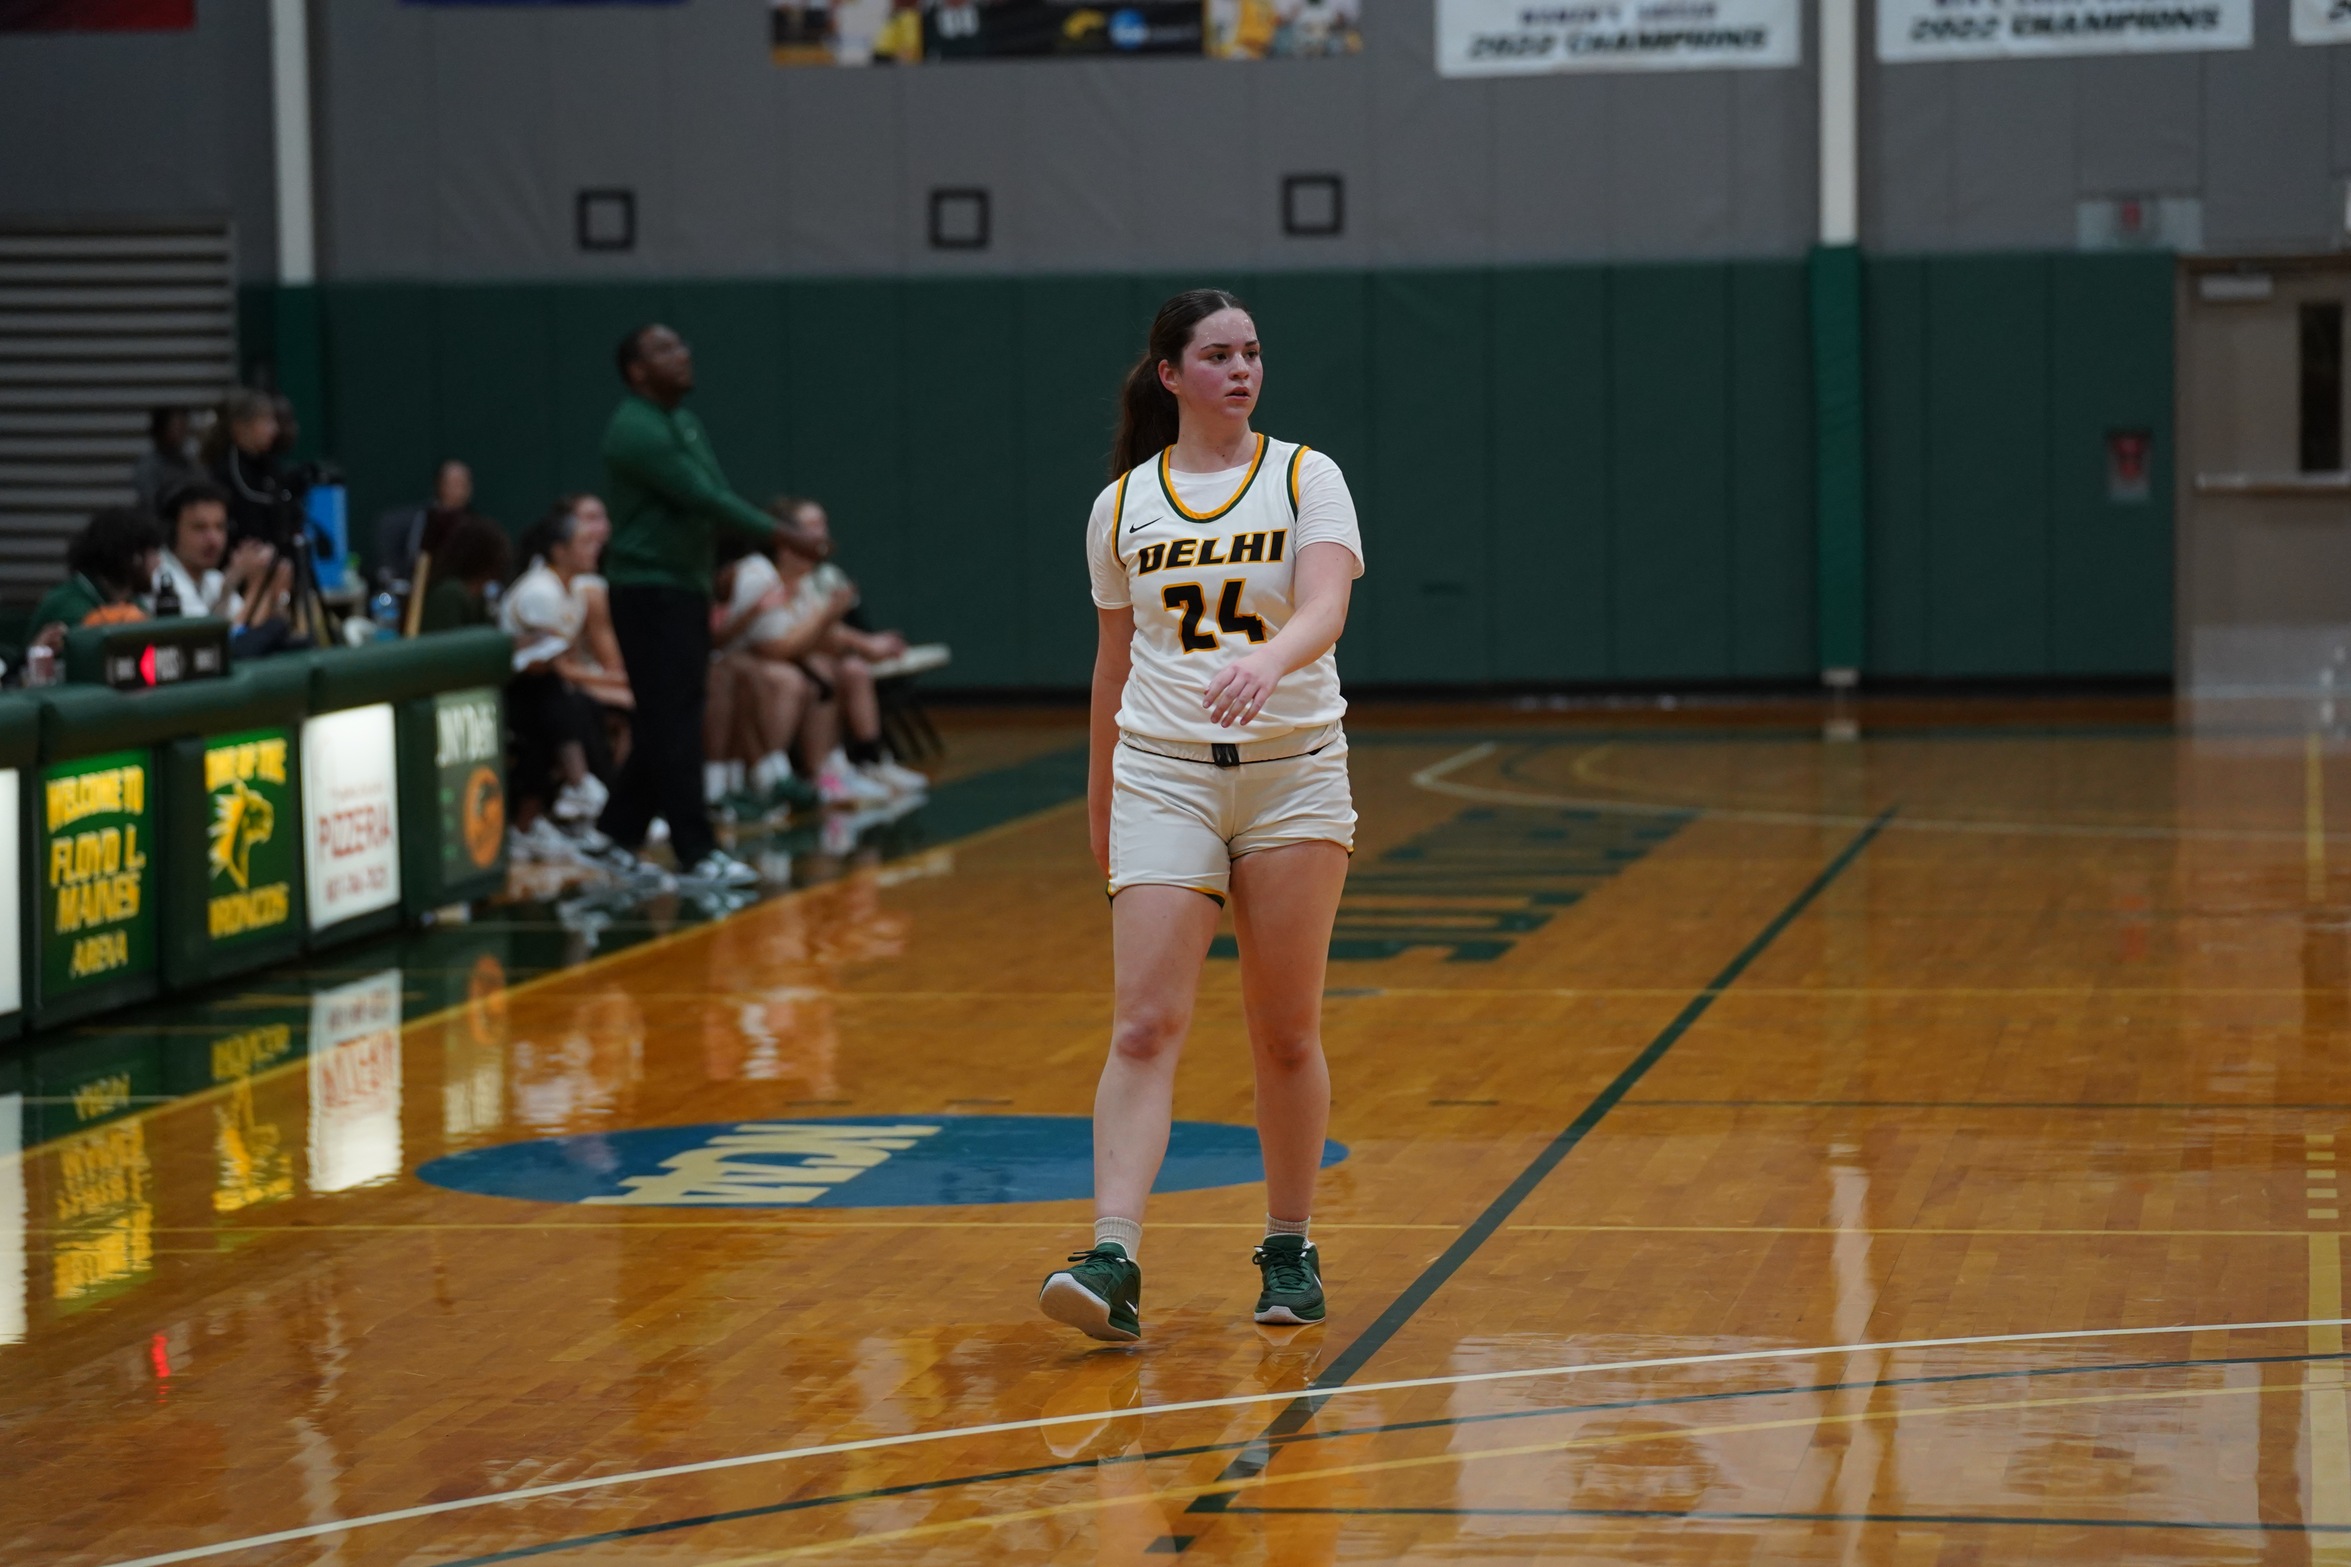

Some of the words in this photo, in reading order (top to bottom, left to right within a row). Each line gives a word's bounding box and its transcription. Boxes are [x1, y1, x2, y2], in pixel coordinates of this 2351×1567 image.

[1564, 24, 1768, 53] CHAMPIONS
[2010, 5, 2222, 39] CHAMPIONS
[1137, 528, 1288, 577] DELHI
[1161, 578, 1269, 655] 24
[50, 826, 121, 889] FLOYD
[318, 802, 391, 866] PIZZERIA
[68, 928, 129, 980] ARENA
